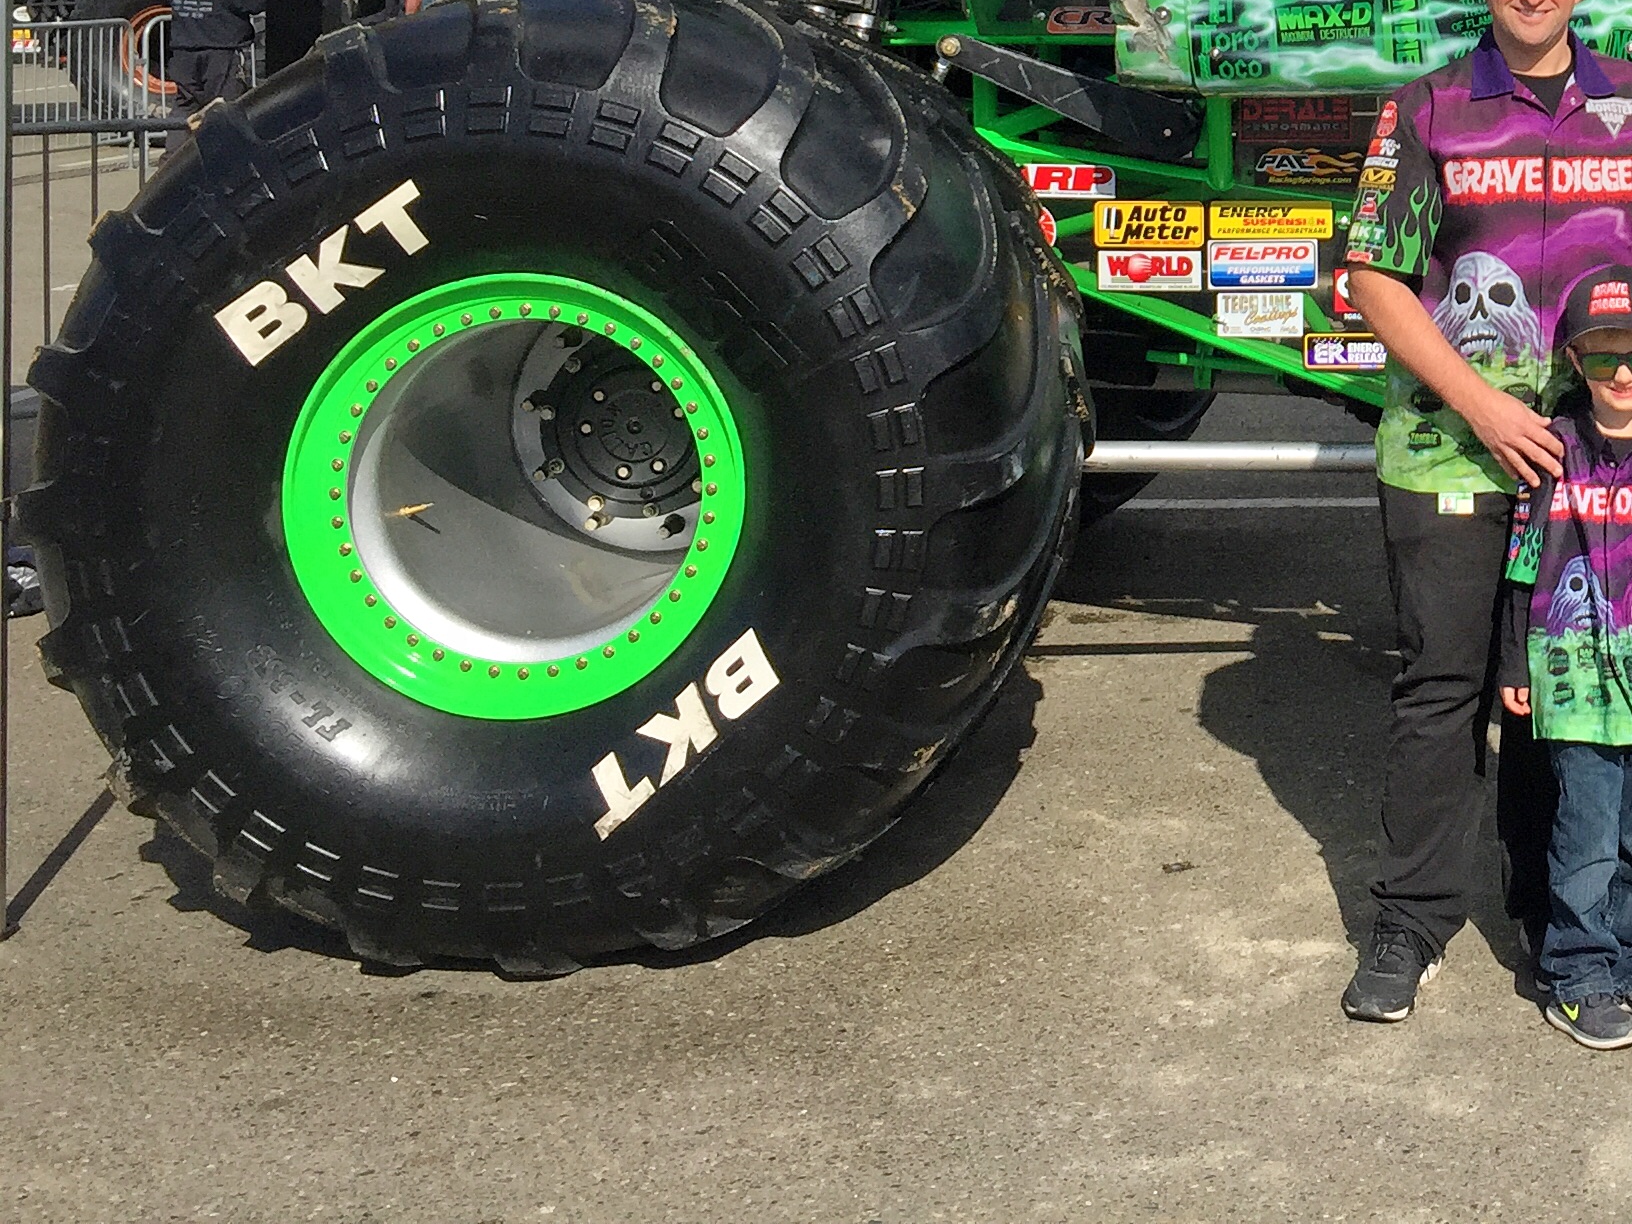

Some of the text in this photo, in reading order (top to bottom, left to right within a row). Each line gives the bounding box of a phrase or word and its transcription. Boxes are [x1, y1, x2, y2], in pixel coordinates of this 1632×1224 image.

[1275, 1, 1373, 31] MAX-D
[1199, 21, 1260, 54] Toro
[1319, 26, 1371, 41] DESTRUCTION
[1198, 54, 1263, 80] Loco
[1243, 98, 1349, 121] DERALE
[1257, 154, 1317, 171] PAC
[1443, 158, 1545, 196] GRAVE
[1128, 205, 1187, 222] Auto
[1218, 206, 1294, 218] ENERGY
[1242, 218, 1326, 226] SUSPENSION
[1122, 223, 1200, 244] Meter
[1213, 246, 1310, 261] FEL-PRO
[212, 179, 432, 367] BKT
[1106, 254, 1194, 282] WORLD
[1227, 266, 1301, 274] PERFORMANCE
[1239, 275, 1286, 284] GASKETS
[1592, 282, 1629, 297] GRAVE
[1590, 296, 1632, 313] DIGGER
[590, 628, 781, 840] BKT
